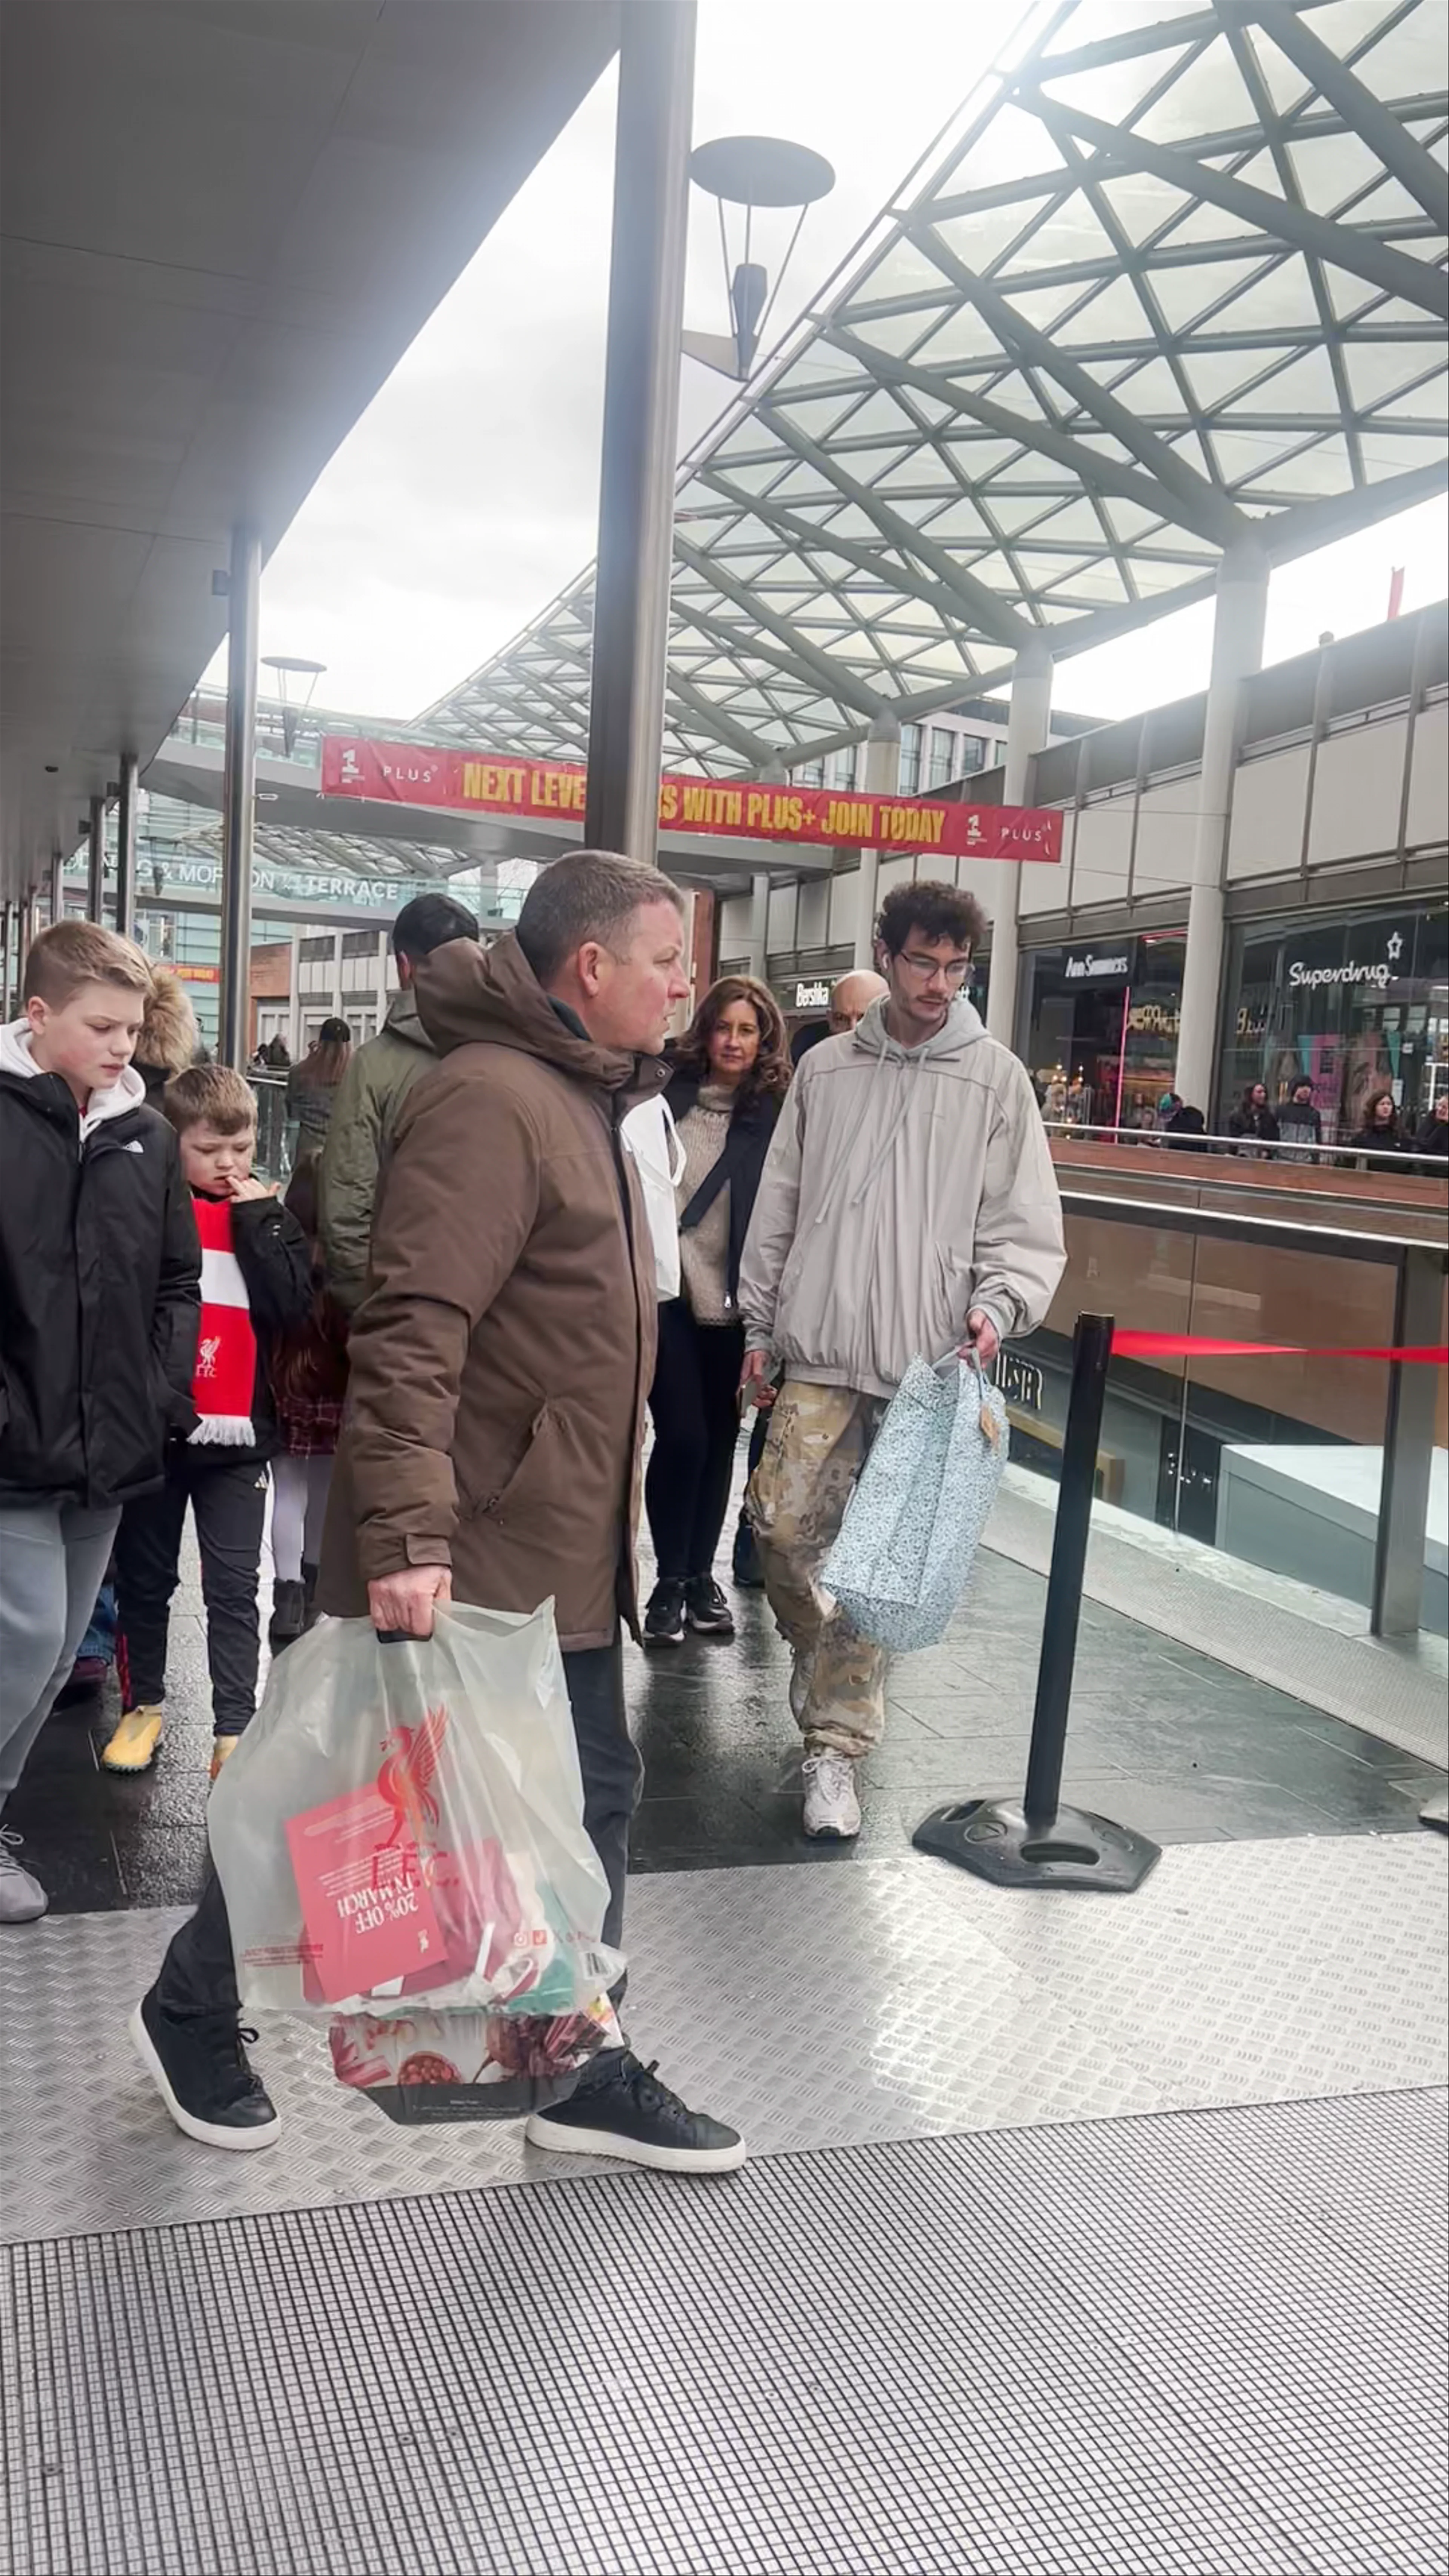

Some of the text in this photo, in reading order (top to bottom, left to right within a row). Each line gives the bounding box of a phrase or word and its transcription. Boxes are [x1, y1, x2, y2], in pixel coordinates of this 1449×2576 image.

[383, 765, 431, 783] PLUS
[463, 762, 526, 804] NEXT
[531, 770, 586, 810] LEVE
[683, 786, 743, 826] WITH
[747, 793, 817, 831] PLUS+
[821, 800, 874, 838] JOIN
[879, 805, 946, 843] TODAY
[1001, 827, 1042, 842] PLUS
[305, 875, 399, 900] TERRACE
[1289, 960, 1392, 990] Superdrug
[796, 981, 829, 1007] Bershka
[355, 1906, 385, 1934] OFF
